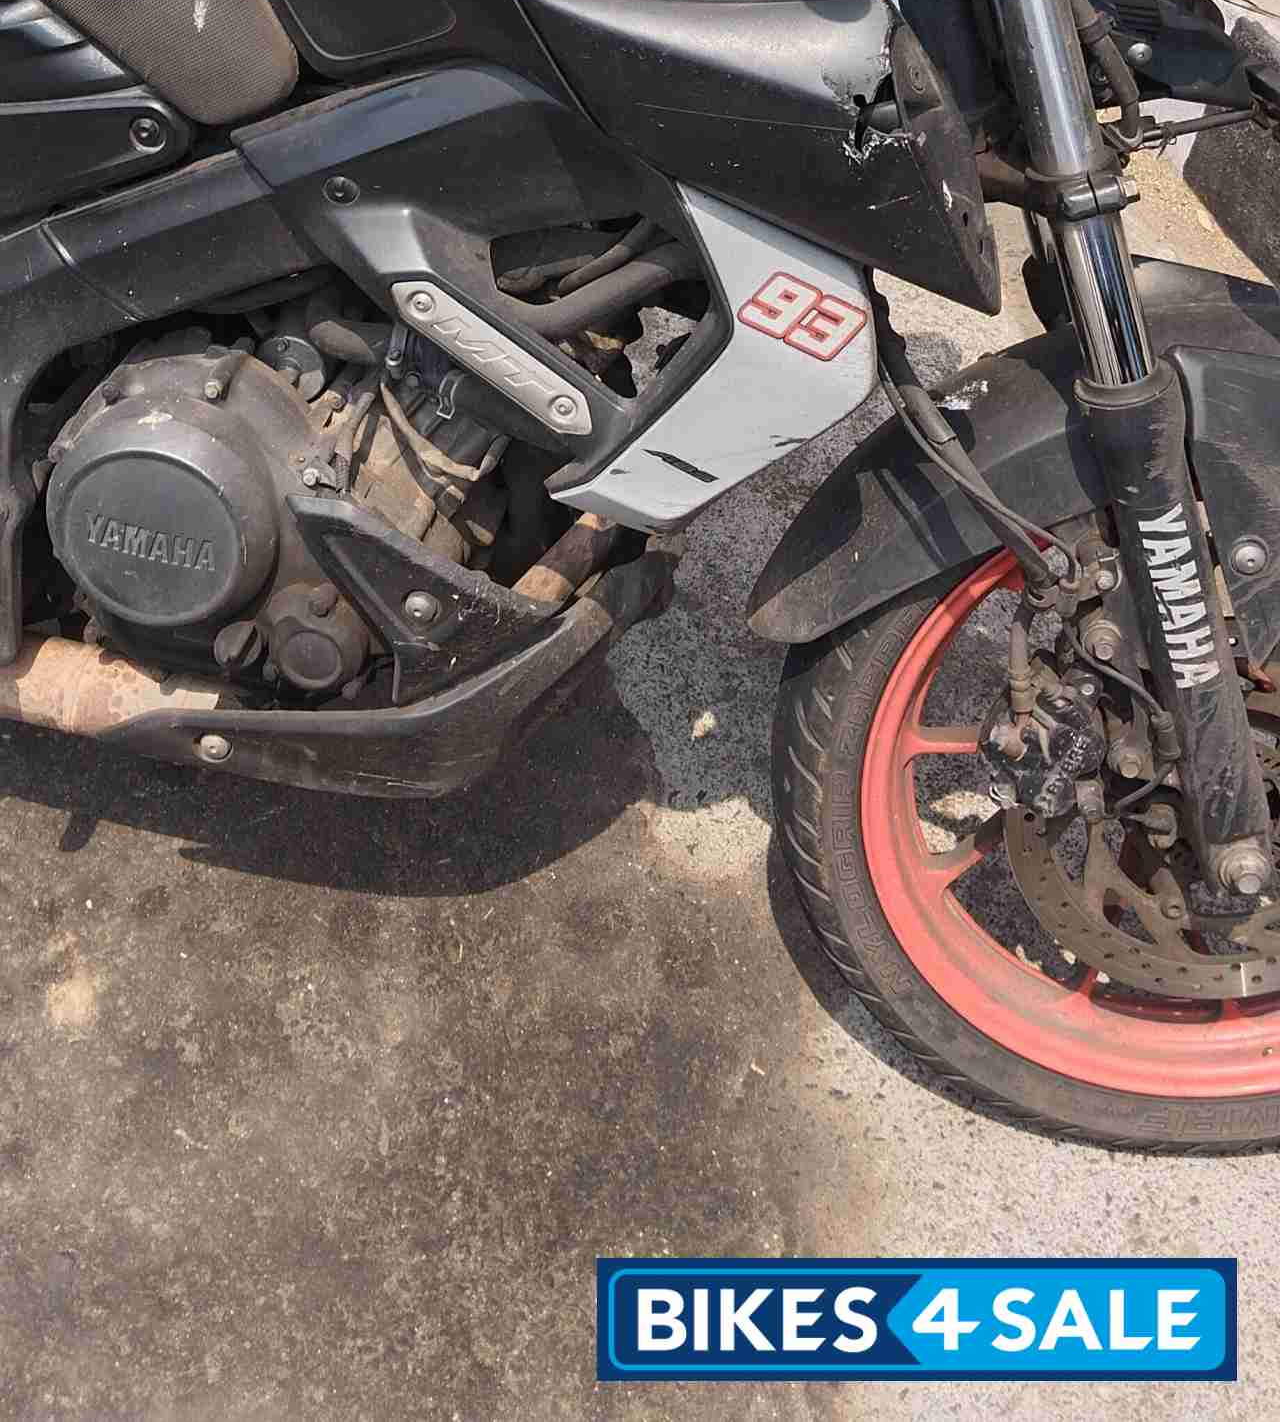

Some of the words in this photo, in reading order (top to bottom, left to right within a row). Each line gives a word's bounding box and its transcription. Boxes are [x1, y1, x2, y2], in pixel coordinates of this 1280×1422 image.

[737, 271, 868, 362] 93
[84, 509, 217, 571] YAMAHA
[1137, 502, 1222, 690] YAMAHA
